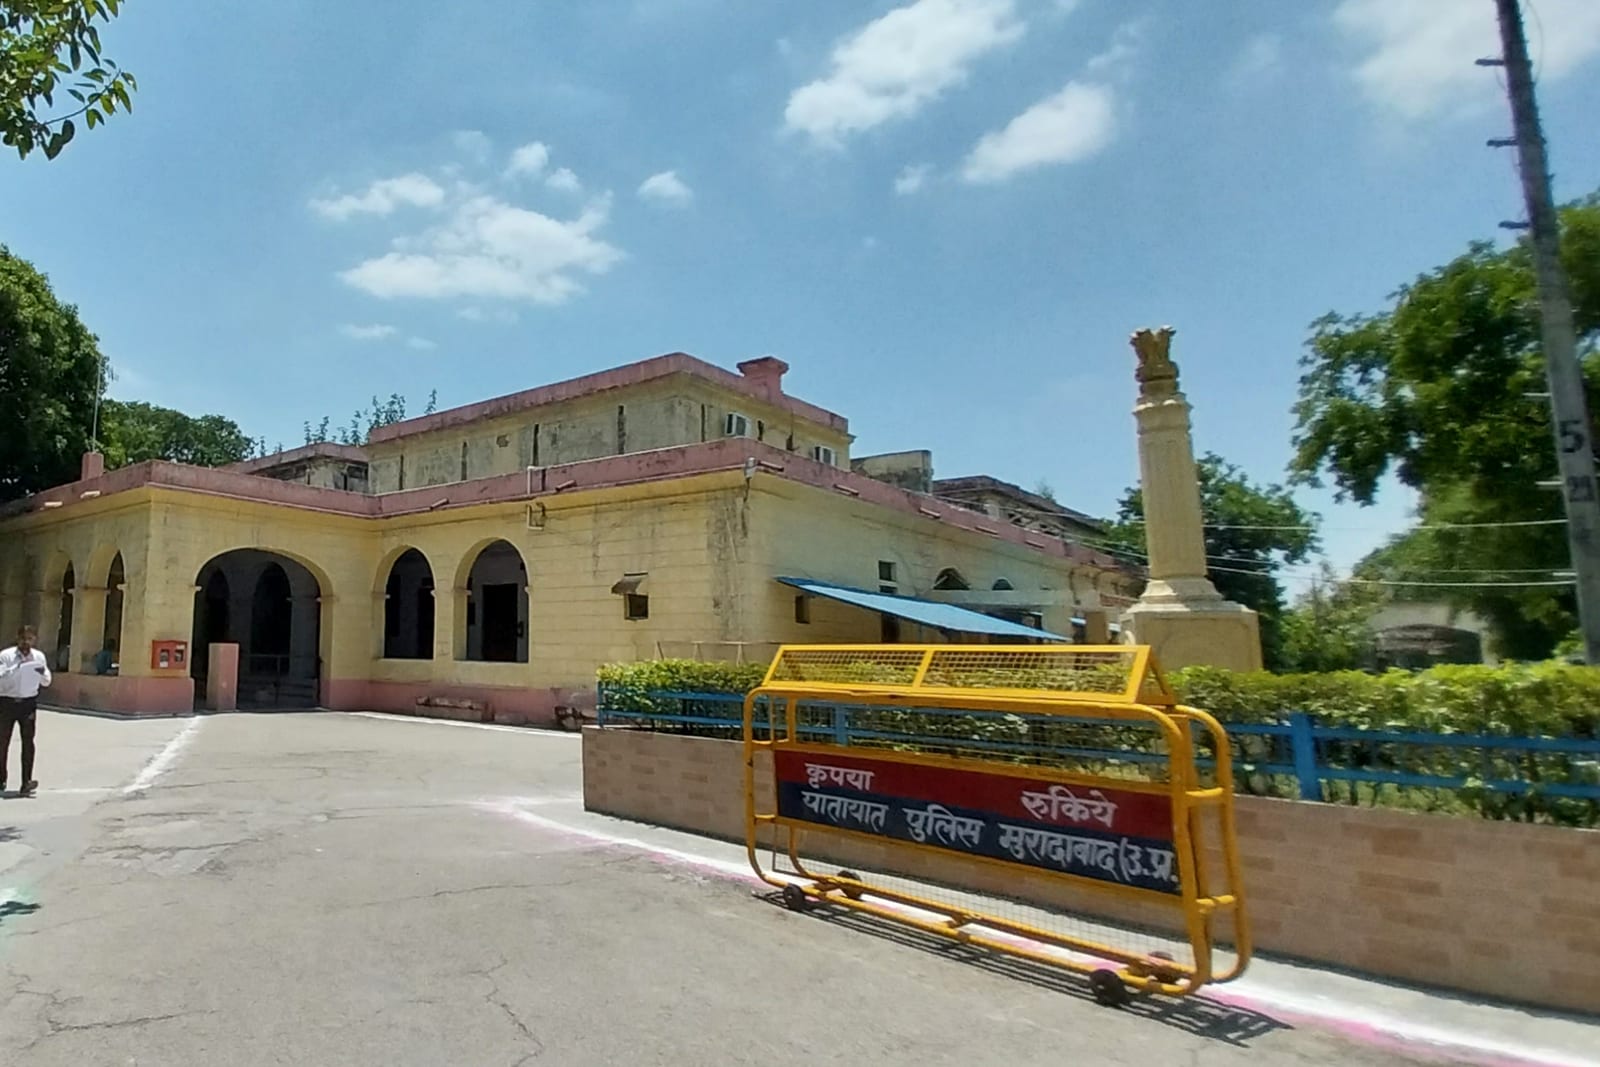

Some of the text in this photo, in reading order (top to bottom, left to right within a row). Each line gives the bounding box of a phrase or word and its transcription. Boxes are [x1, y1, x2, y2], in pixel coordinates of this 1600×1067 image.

[1559, 420, 1585, 454] 5
[804, 763, 875, 791] कृपया
[801, 791, 889, 833] यातायात
[902, 803, 985, 848] पुलिस
